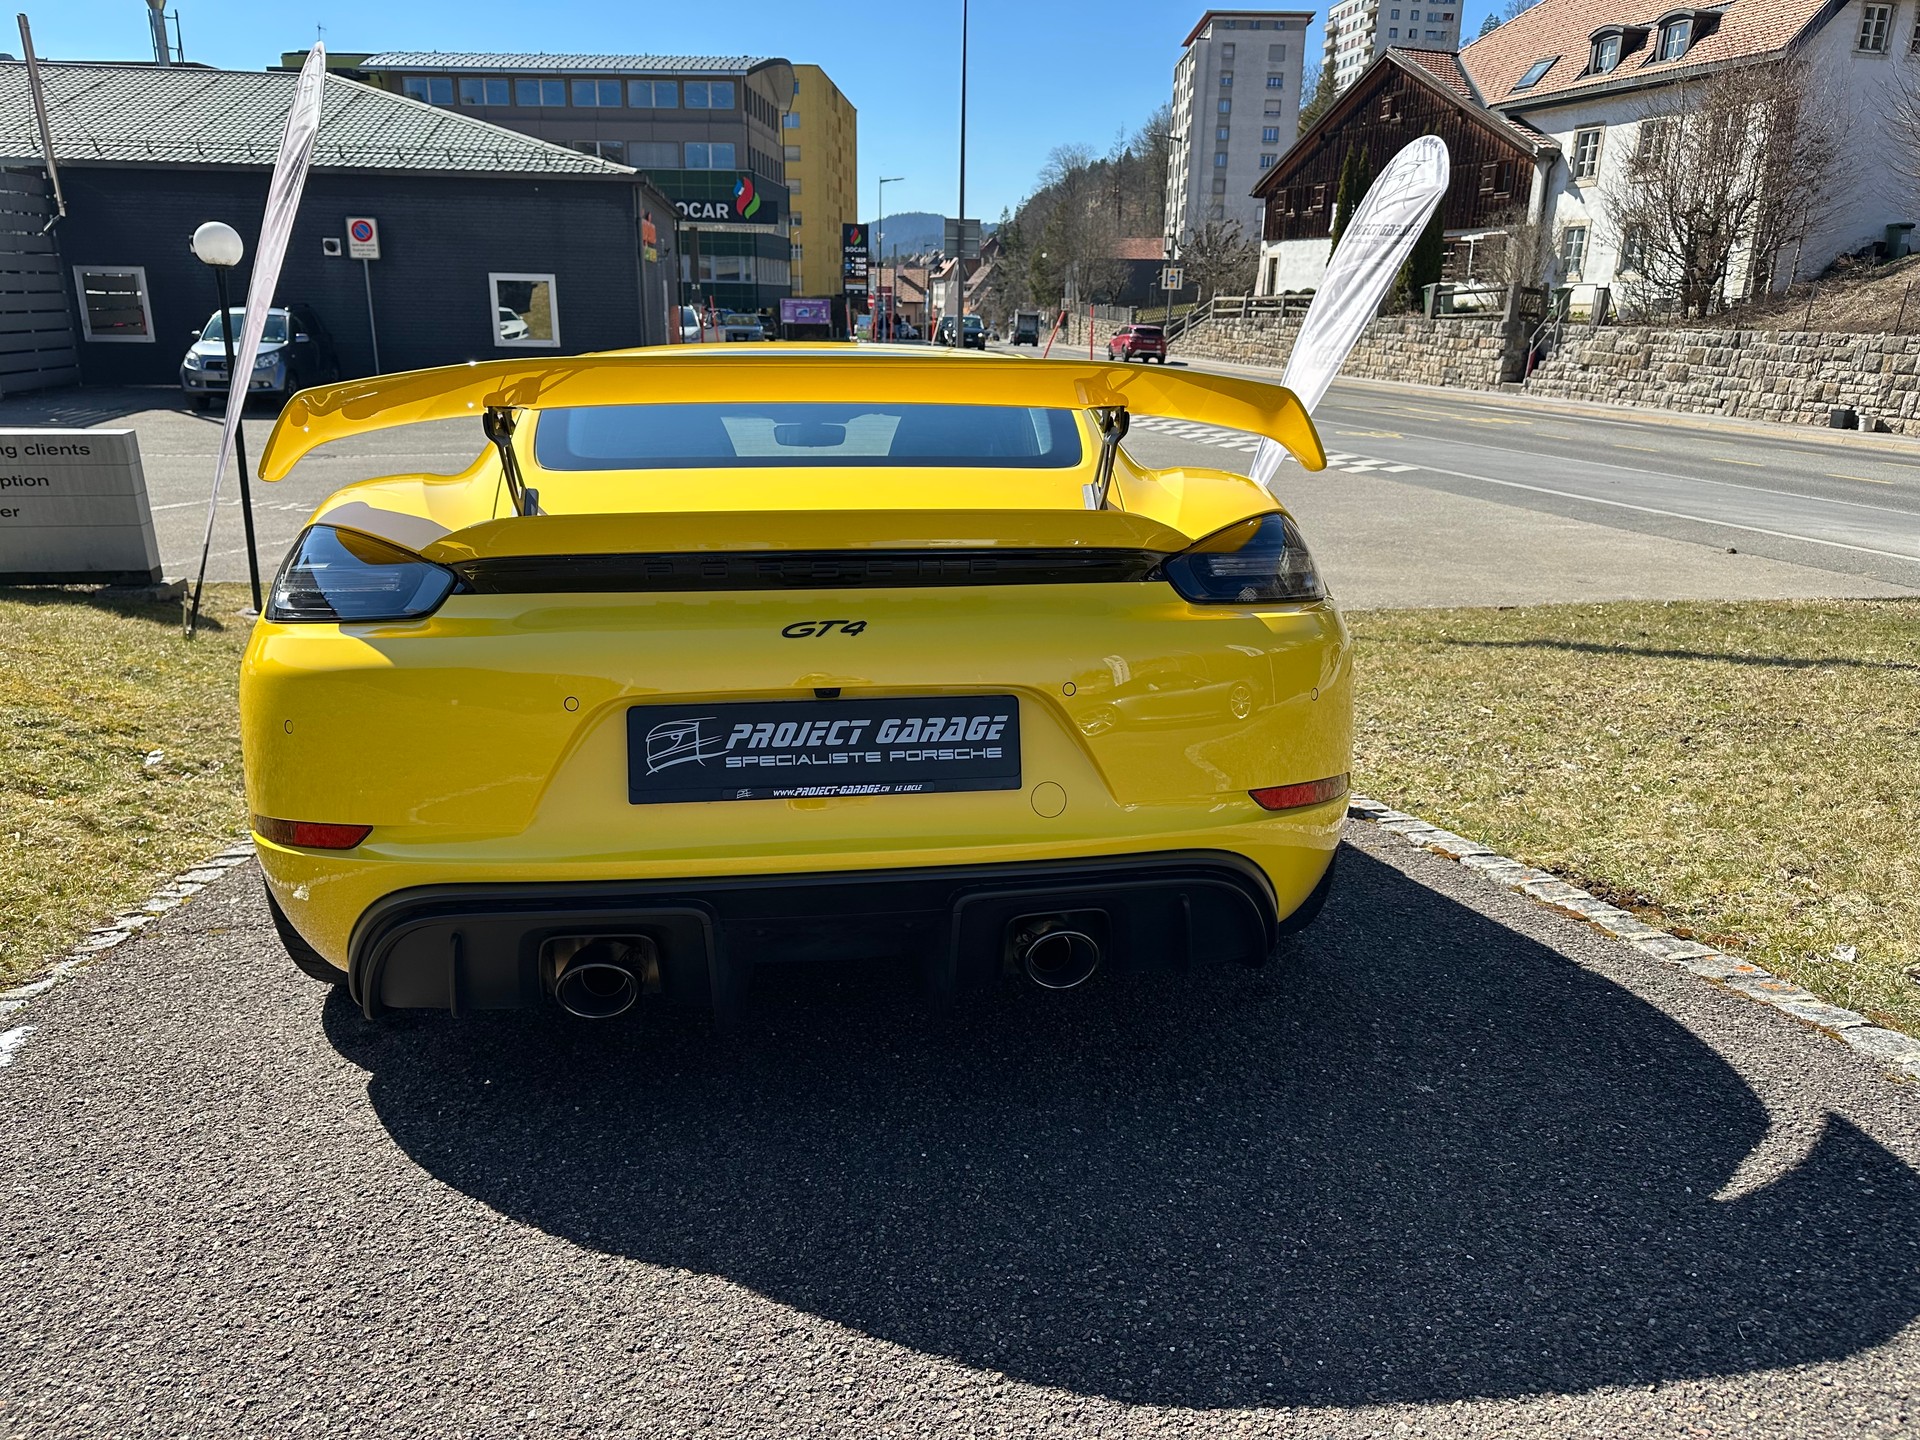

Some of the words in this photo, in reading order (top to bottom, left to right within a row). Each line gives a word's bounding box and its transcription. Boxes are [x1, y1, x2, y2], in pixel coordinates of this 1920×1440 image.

[24, 443, 91, 456] clients
[0, 475, 49, 490] ption
[0, 507, 20, 518] er
[645, 559, 998, 579] PORSCHE
[782, 620, 867, 639] GT4
[726, 720, 871, 749] PROJECT
[876, 715, 1009, 744] GARAGE
[725, 752, 881, 768] SPECIALISTE
[889, 747, 1002, 761] PORSCHE
